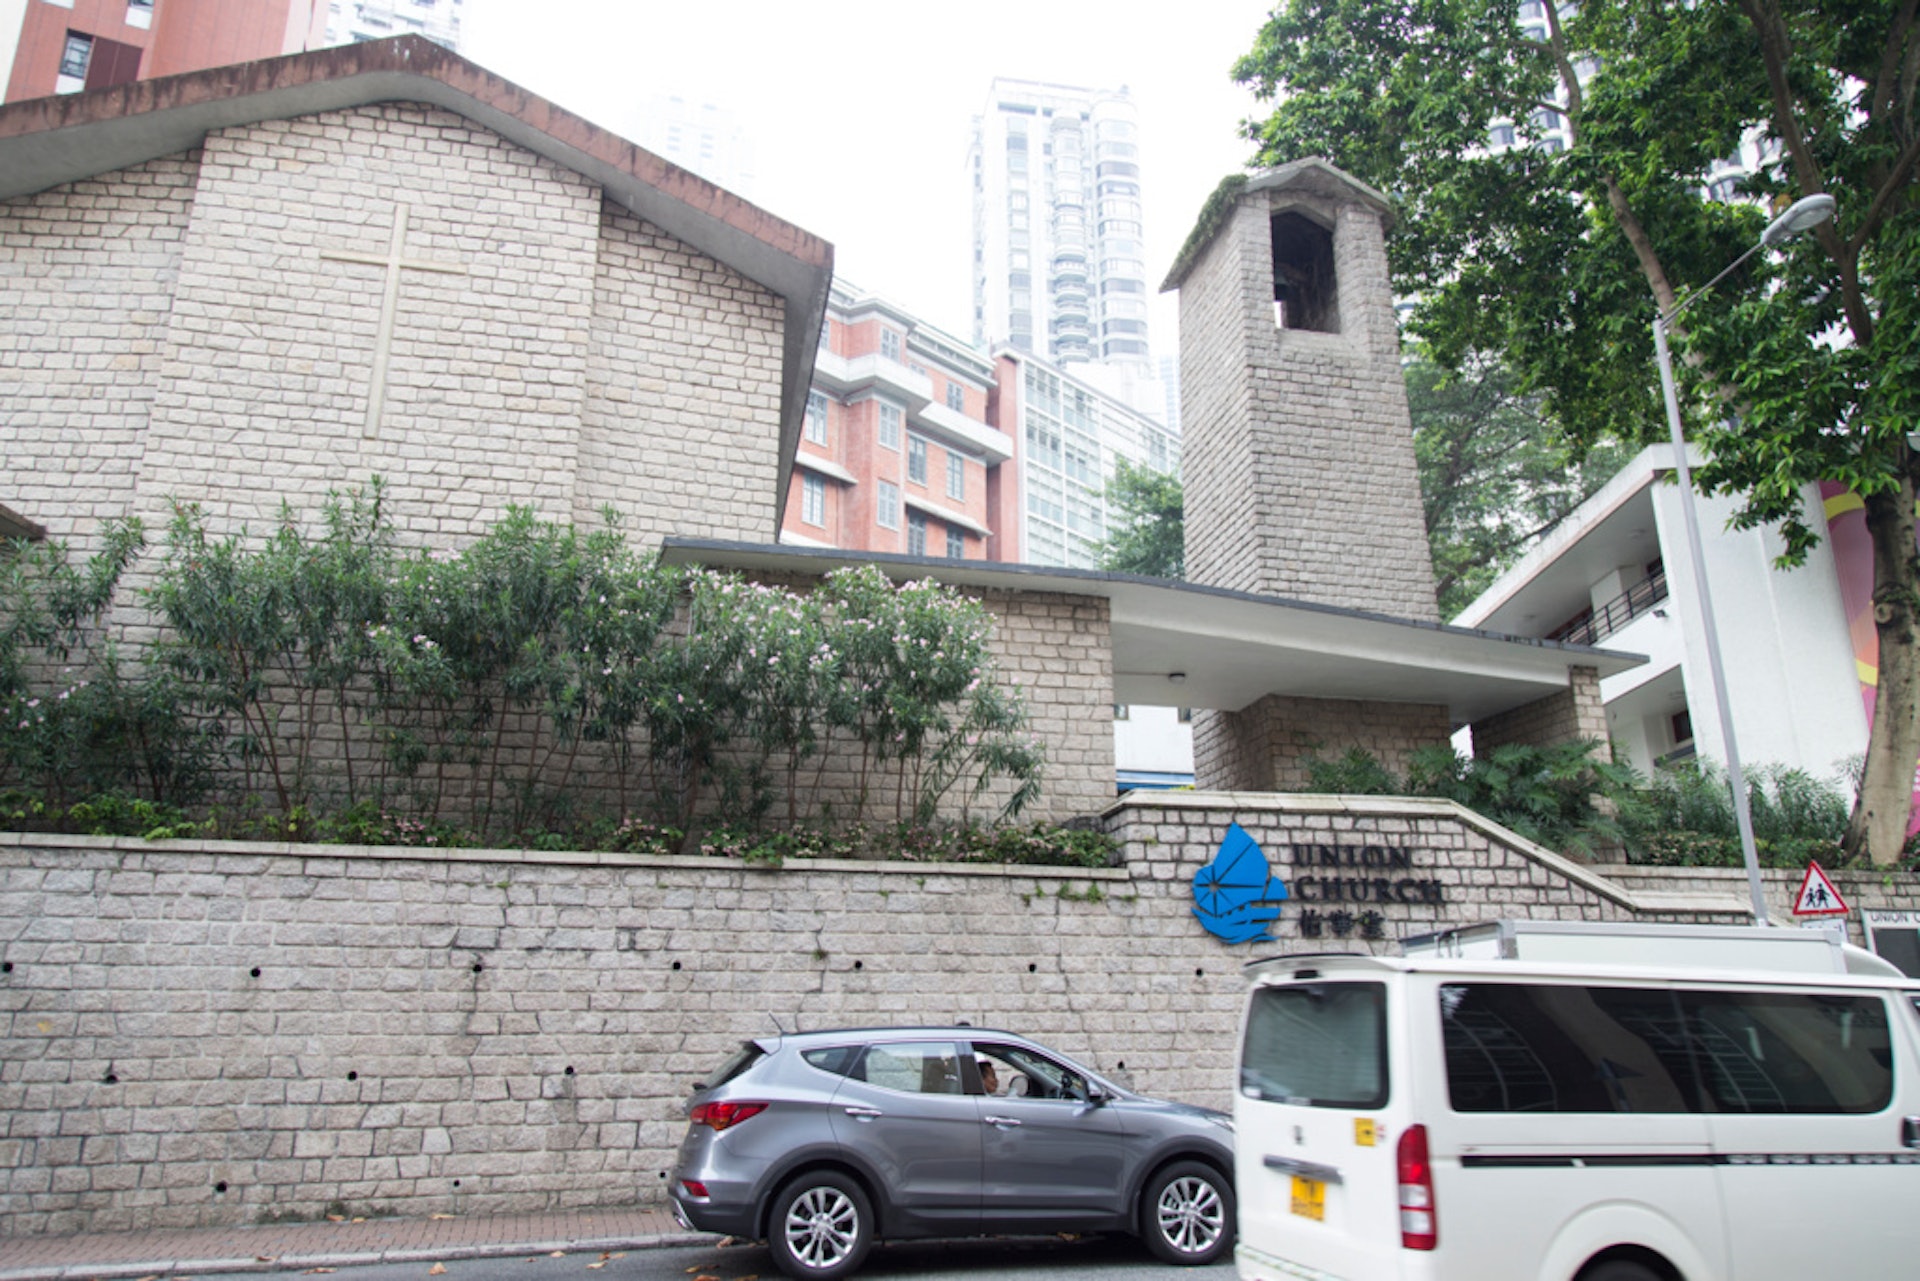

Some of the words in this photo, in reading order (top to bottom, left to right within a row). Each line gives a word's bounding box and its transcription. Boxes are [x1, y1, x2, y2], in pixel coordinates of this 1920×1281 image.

[1293, 843, 1411, 869] UNION
[1295, 876, 1442, 903] CHURCH
[1870, 911, 1908, 922] UNION
